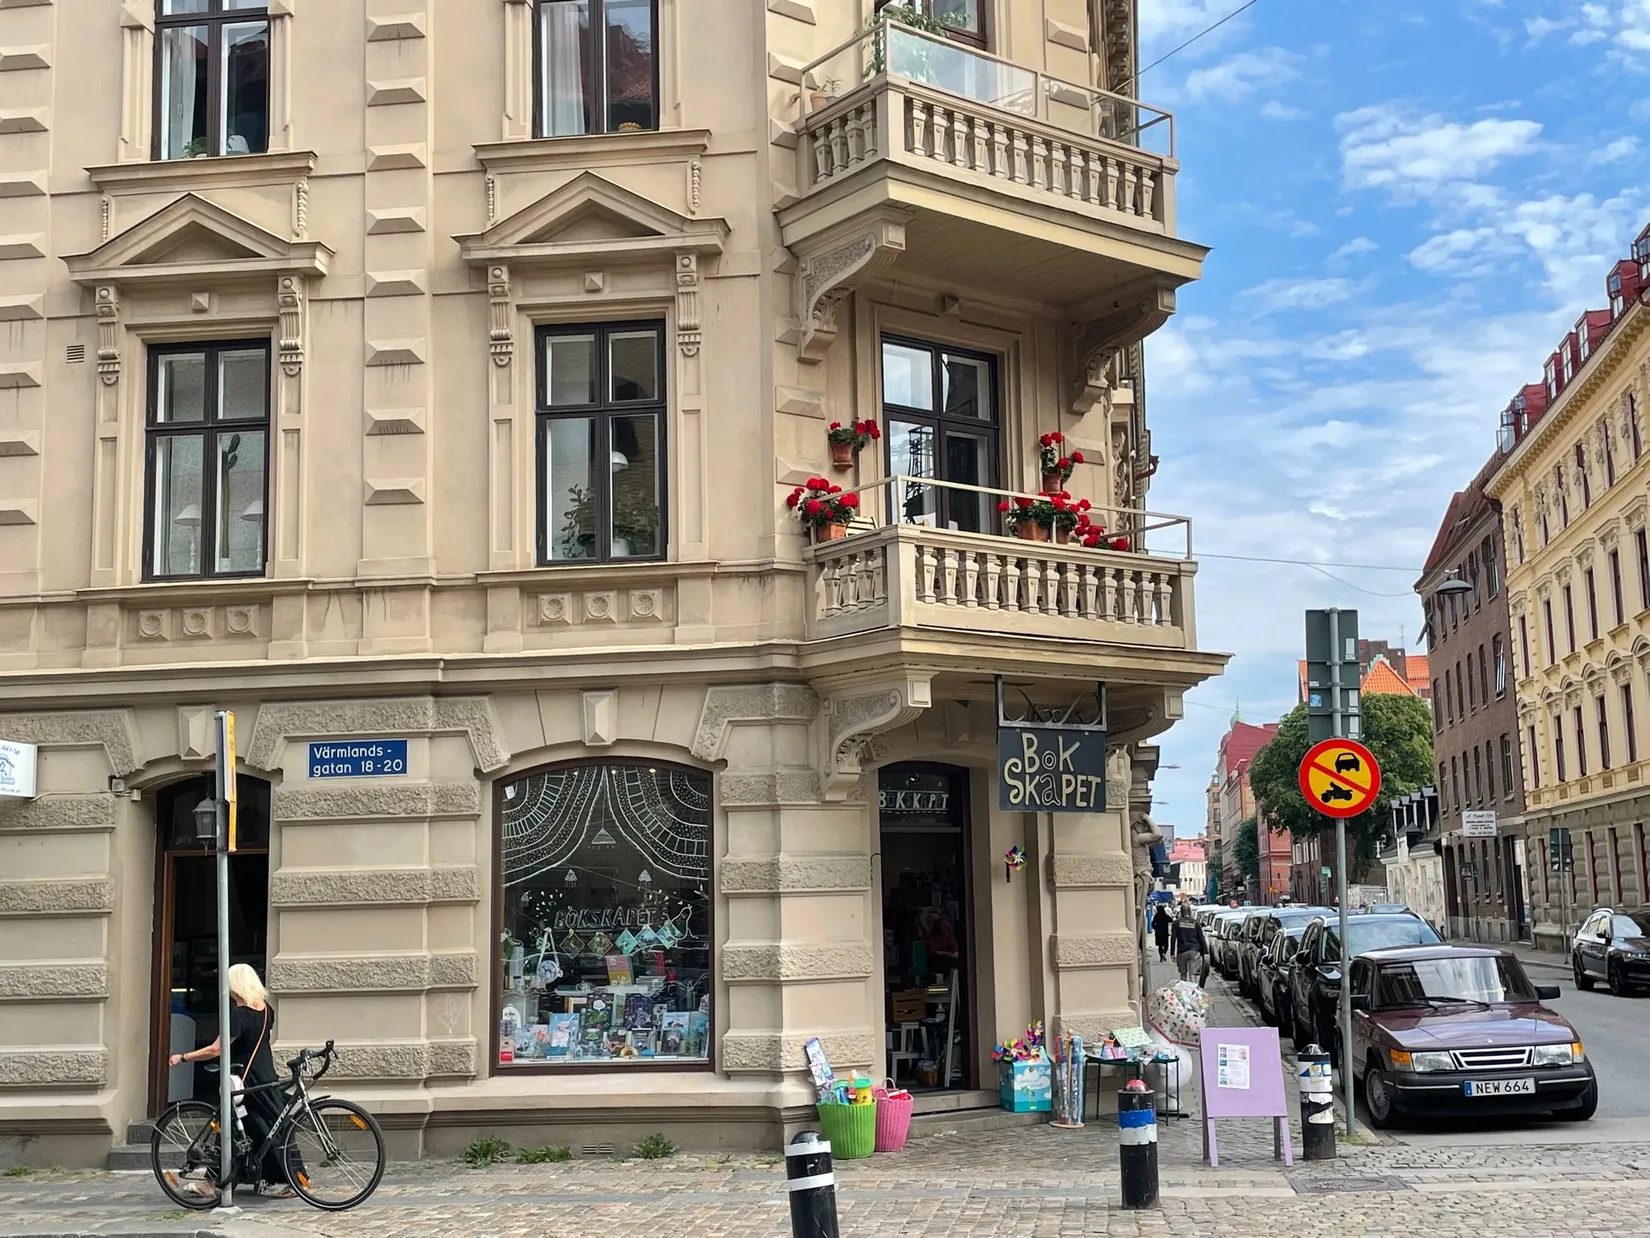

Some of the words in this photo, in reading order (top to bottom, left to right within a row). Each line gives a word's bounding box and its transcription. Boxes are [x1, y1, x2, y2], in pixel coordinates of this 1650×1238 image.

[313, 762, 352, 778] gatan
[1476, 1081, 1500, 1095] NEW
[1504, 1080, 1530, 1093] 664
